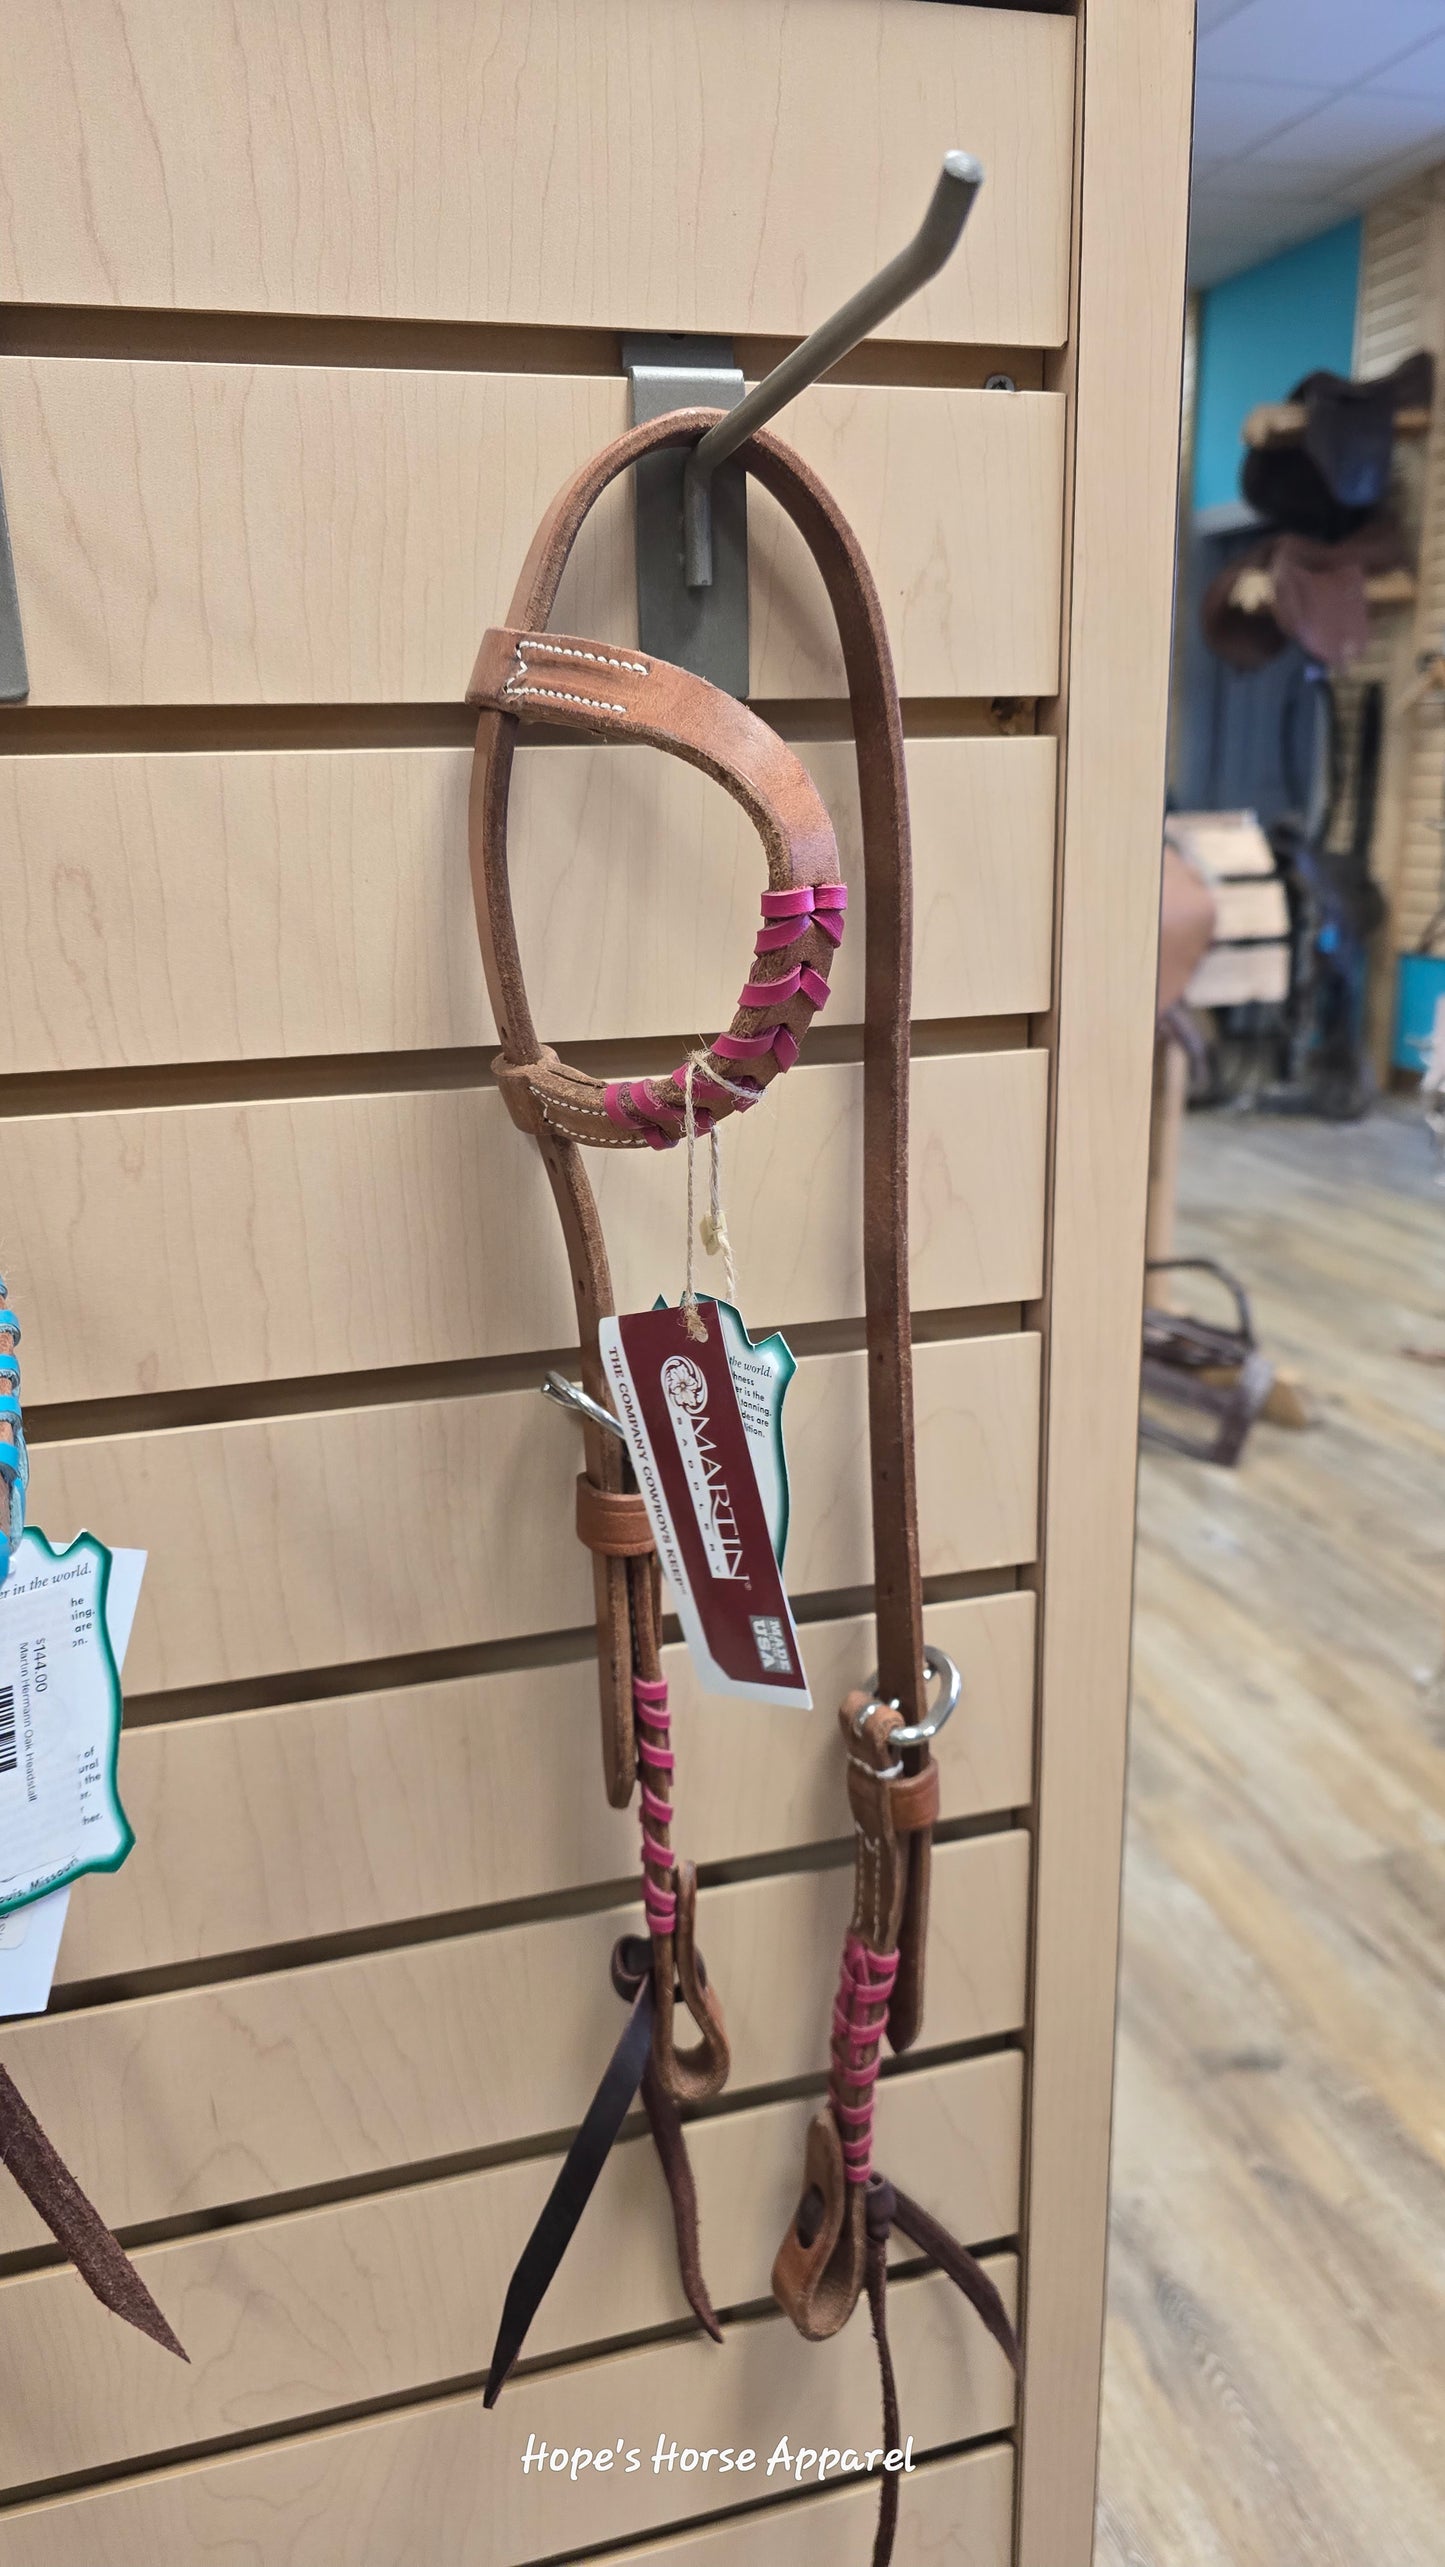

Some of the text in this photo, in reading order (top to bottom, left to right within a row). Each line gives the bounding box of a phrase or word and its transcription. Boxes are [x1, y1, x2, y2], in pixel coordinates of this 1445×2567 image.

[744, 1364, 773, 1378] world.
[744, 1387, 751, 1397] is
[752, 1390, 765, 1402] the
[756, 1418, 769, 1427] are
[608, 1346, 624, 1378] THE
[619, 1382, 648, 1461] COMPANY
[642, 1466, 672, 1543] COWBOYS
[13, 1583, 26, 1596] in
[30, 1576, 49, 1591] the
[52, 1562, 92, 1584] world.
[74, 1621, 93, 1633] are
[752, 1619, 775, 1668] USA
[769, 1620, 791, 1671] MADE
[33, 1637, 48, 1693] $144.00
[19, 1642, 38, 1803] Martin Hermann Oak Headstall
[84, 1745, 95, 1758] of
[84, 1774, 102, 1785] the
[29, 1855, 79, 1892] Missouri
